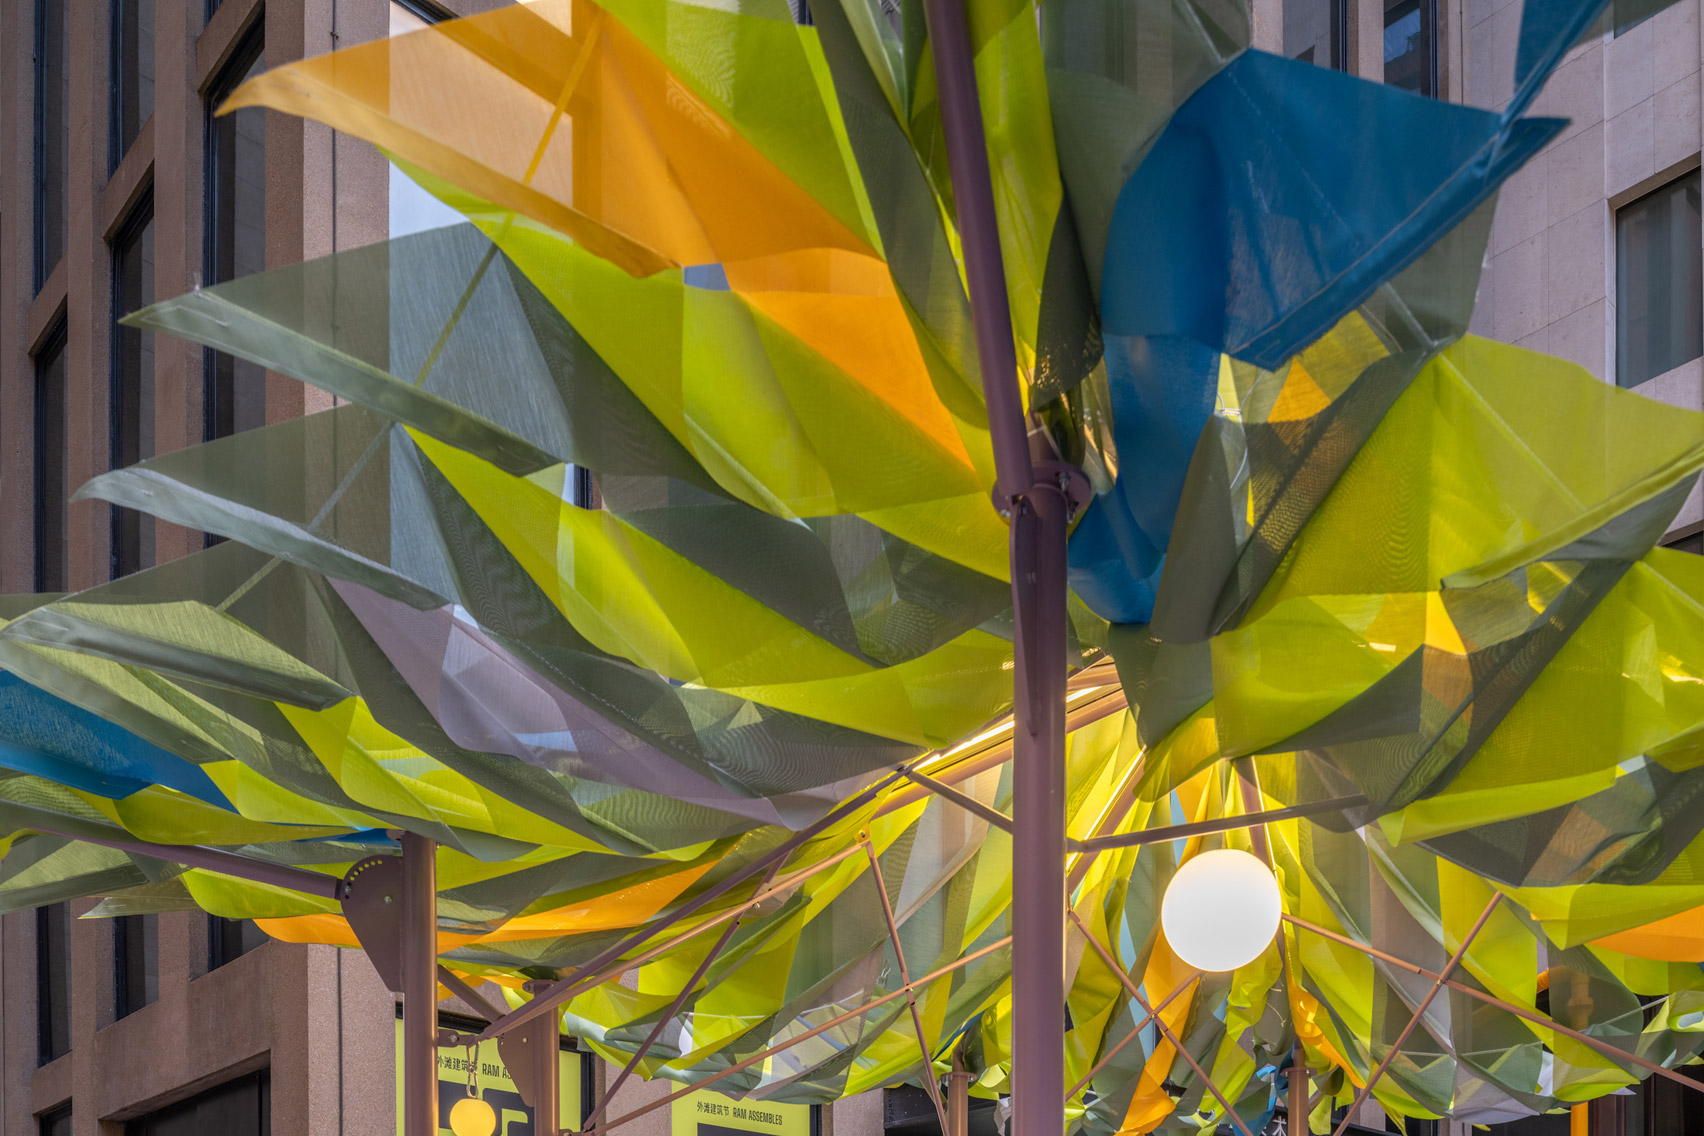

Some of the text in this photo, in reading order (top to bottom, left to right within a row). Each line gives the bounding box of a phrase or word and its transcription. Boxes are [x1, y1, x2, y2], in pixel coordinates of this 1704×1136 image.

[482, 1063, 500, 1078] RAM
[733, 1107, 747, 1120] RAM
[748, 1110, 783, 1126] ASSEMBLES
